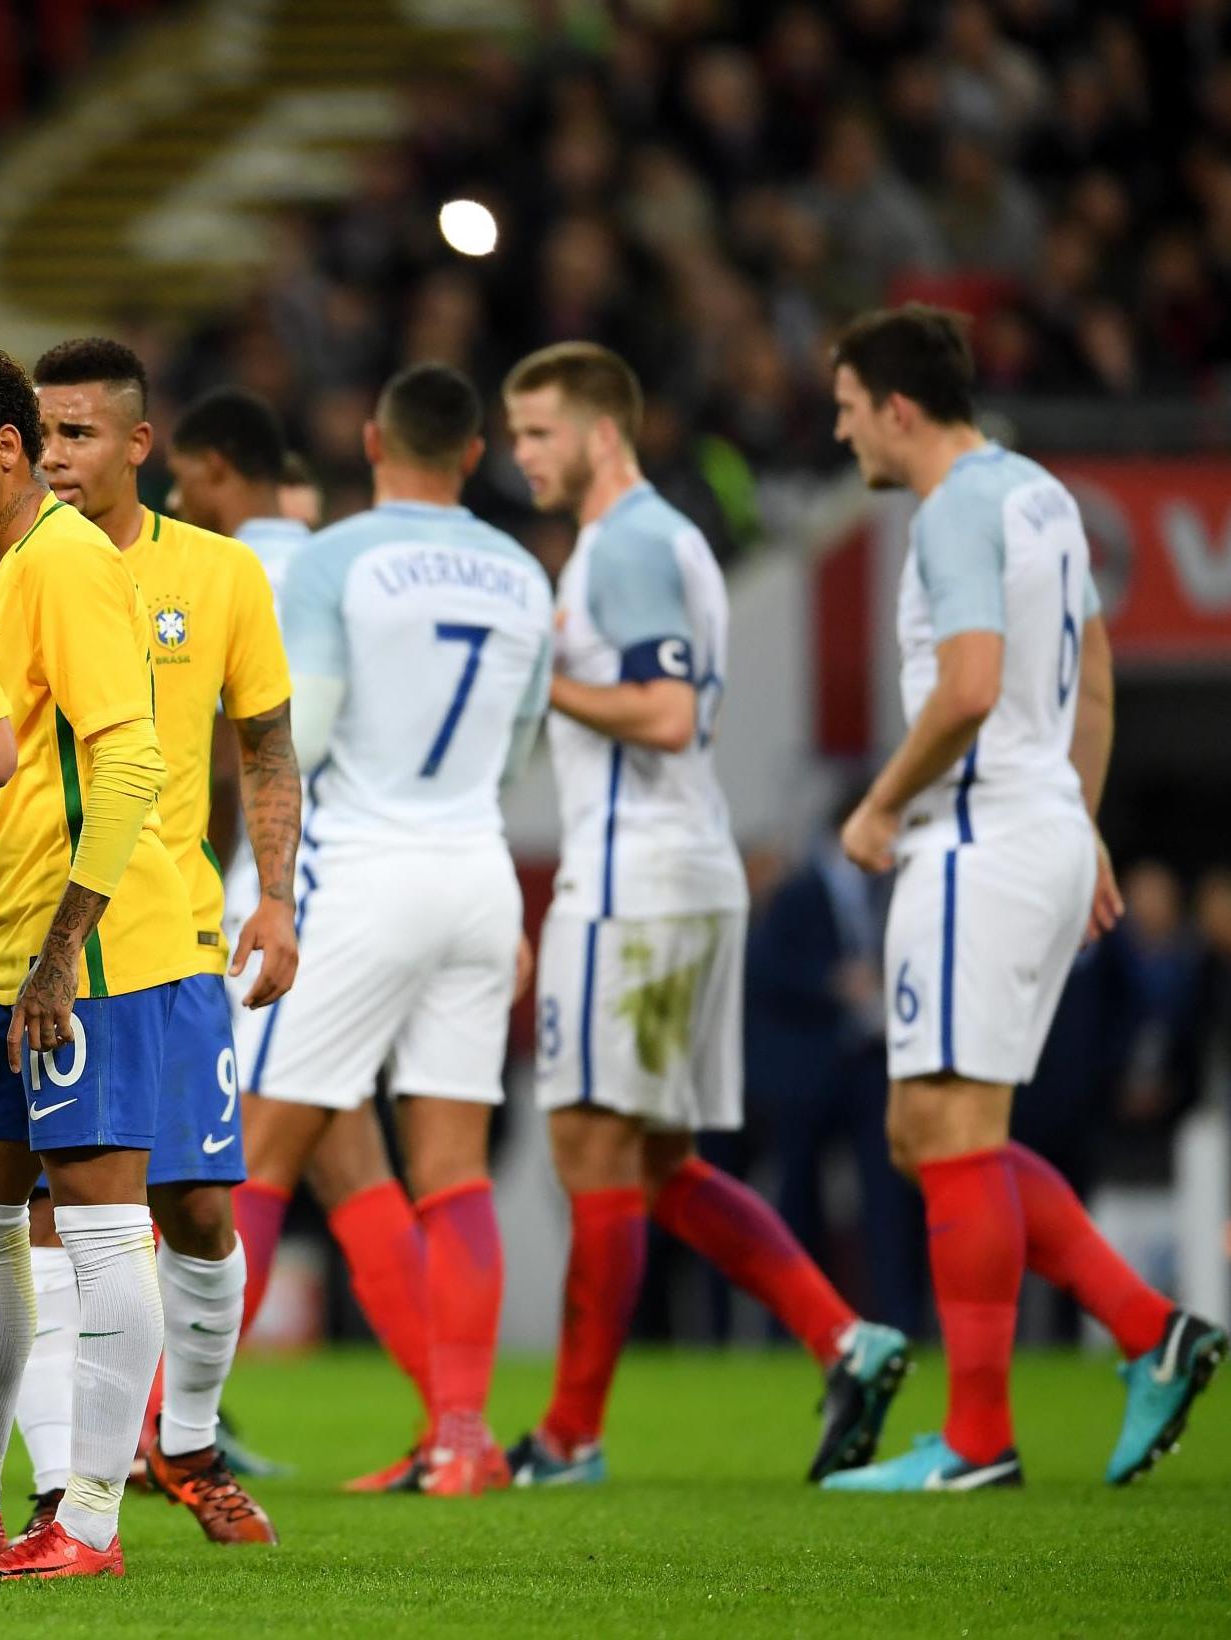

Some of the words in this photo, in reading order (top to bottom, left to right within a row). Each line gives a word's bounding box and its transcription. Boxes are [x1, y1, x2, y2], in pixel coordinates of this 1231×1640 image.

[657, 639, 689, 677] C
[1058, 551, 1079, 708] 6
[420, 622, 493, 778] 7
[895, 960, 919, 1026] 6
[217, 1047, 237, 1122] 9
